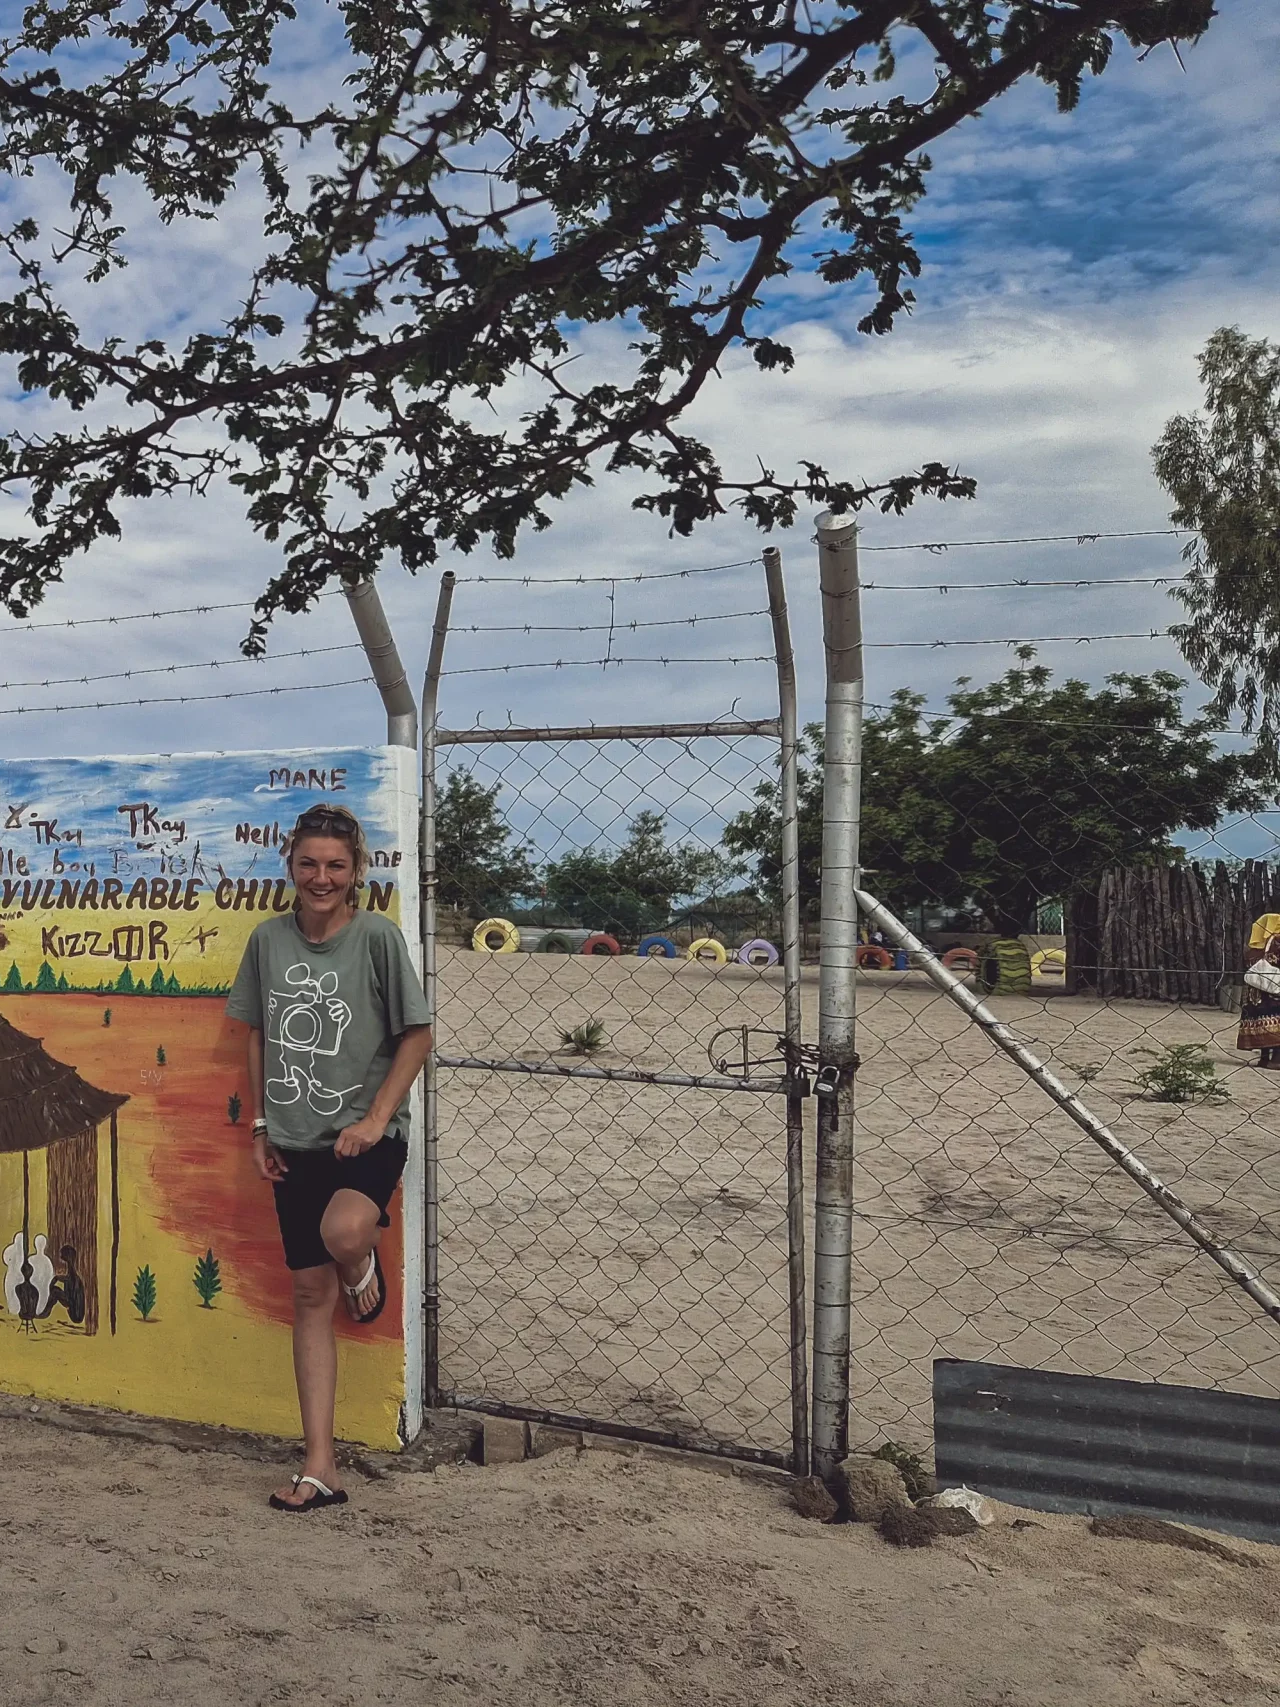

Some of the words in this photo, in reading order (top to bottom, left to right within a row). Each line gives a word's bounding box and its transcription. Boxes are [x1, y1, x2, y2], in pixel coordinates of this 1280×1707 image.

[269, 768, 347, 791] MANE
[1, 878, 204, 912] VULNARABLE
[215, 878, 395, 913] CHILN
